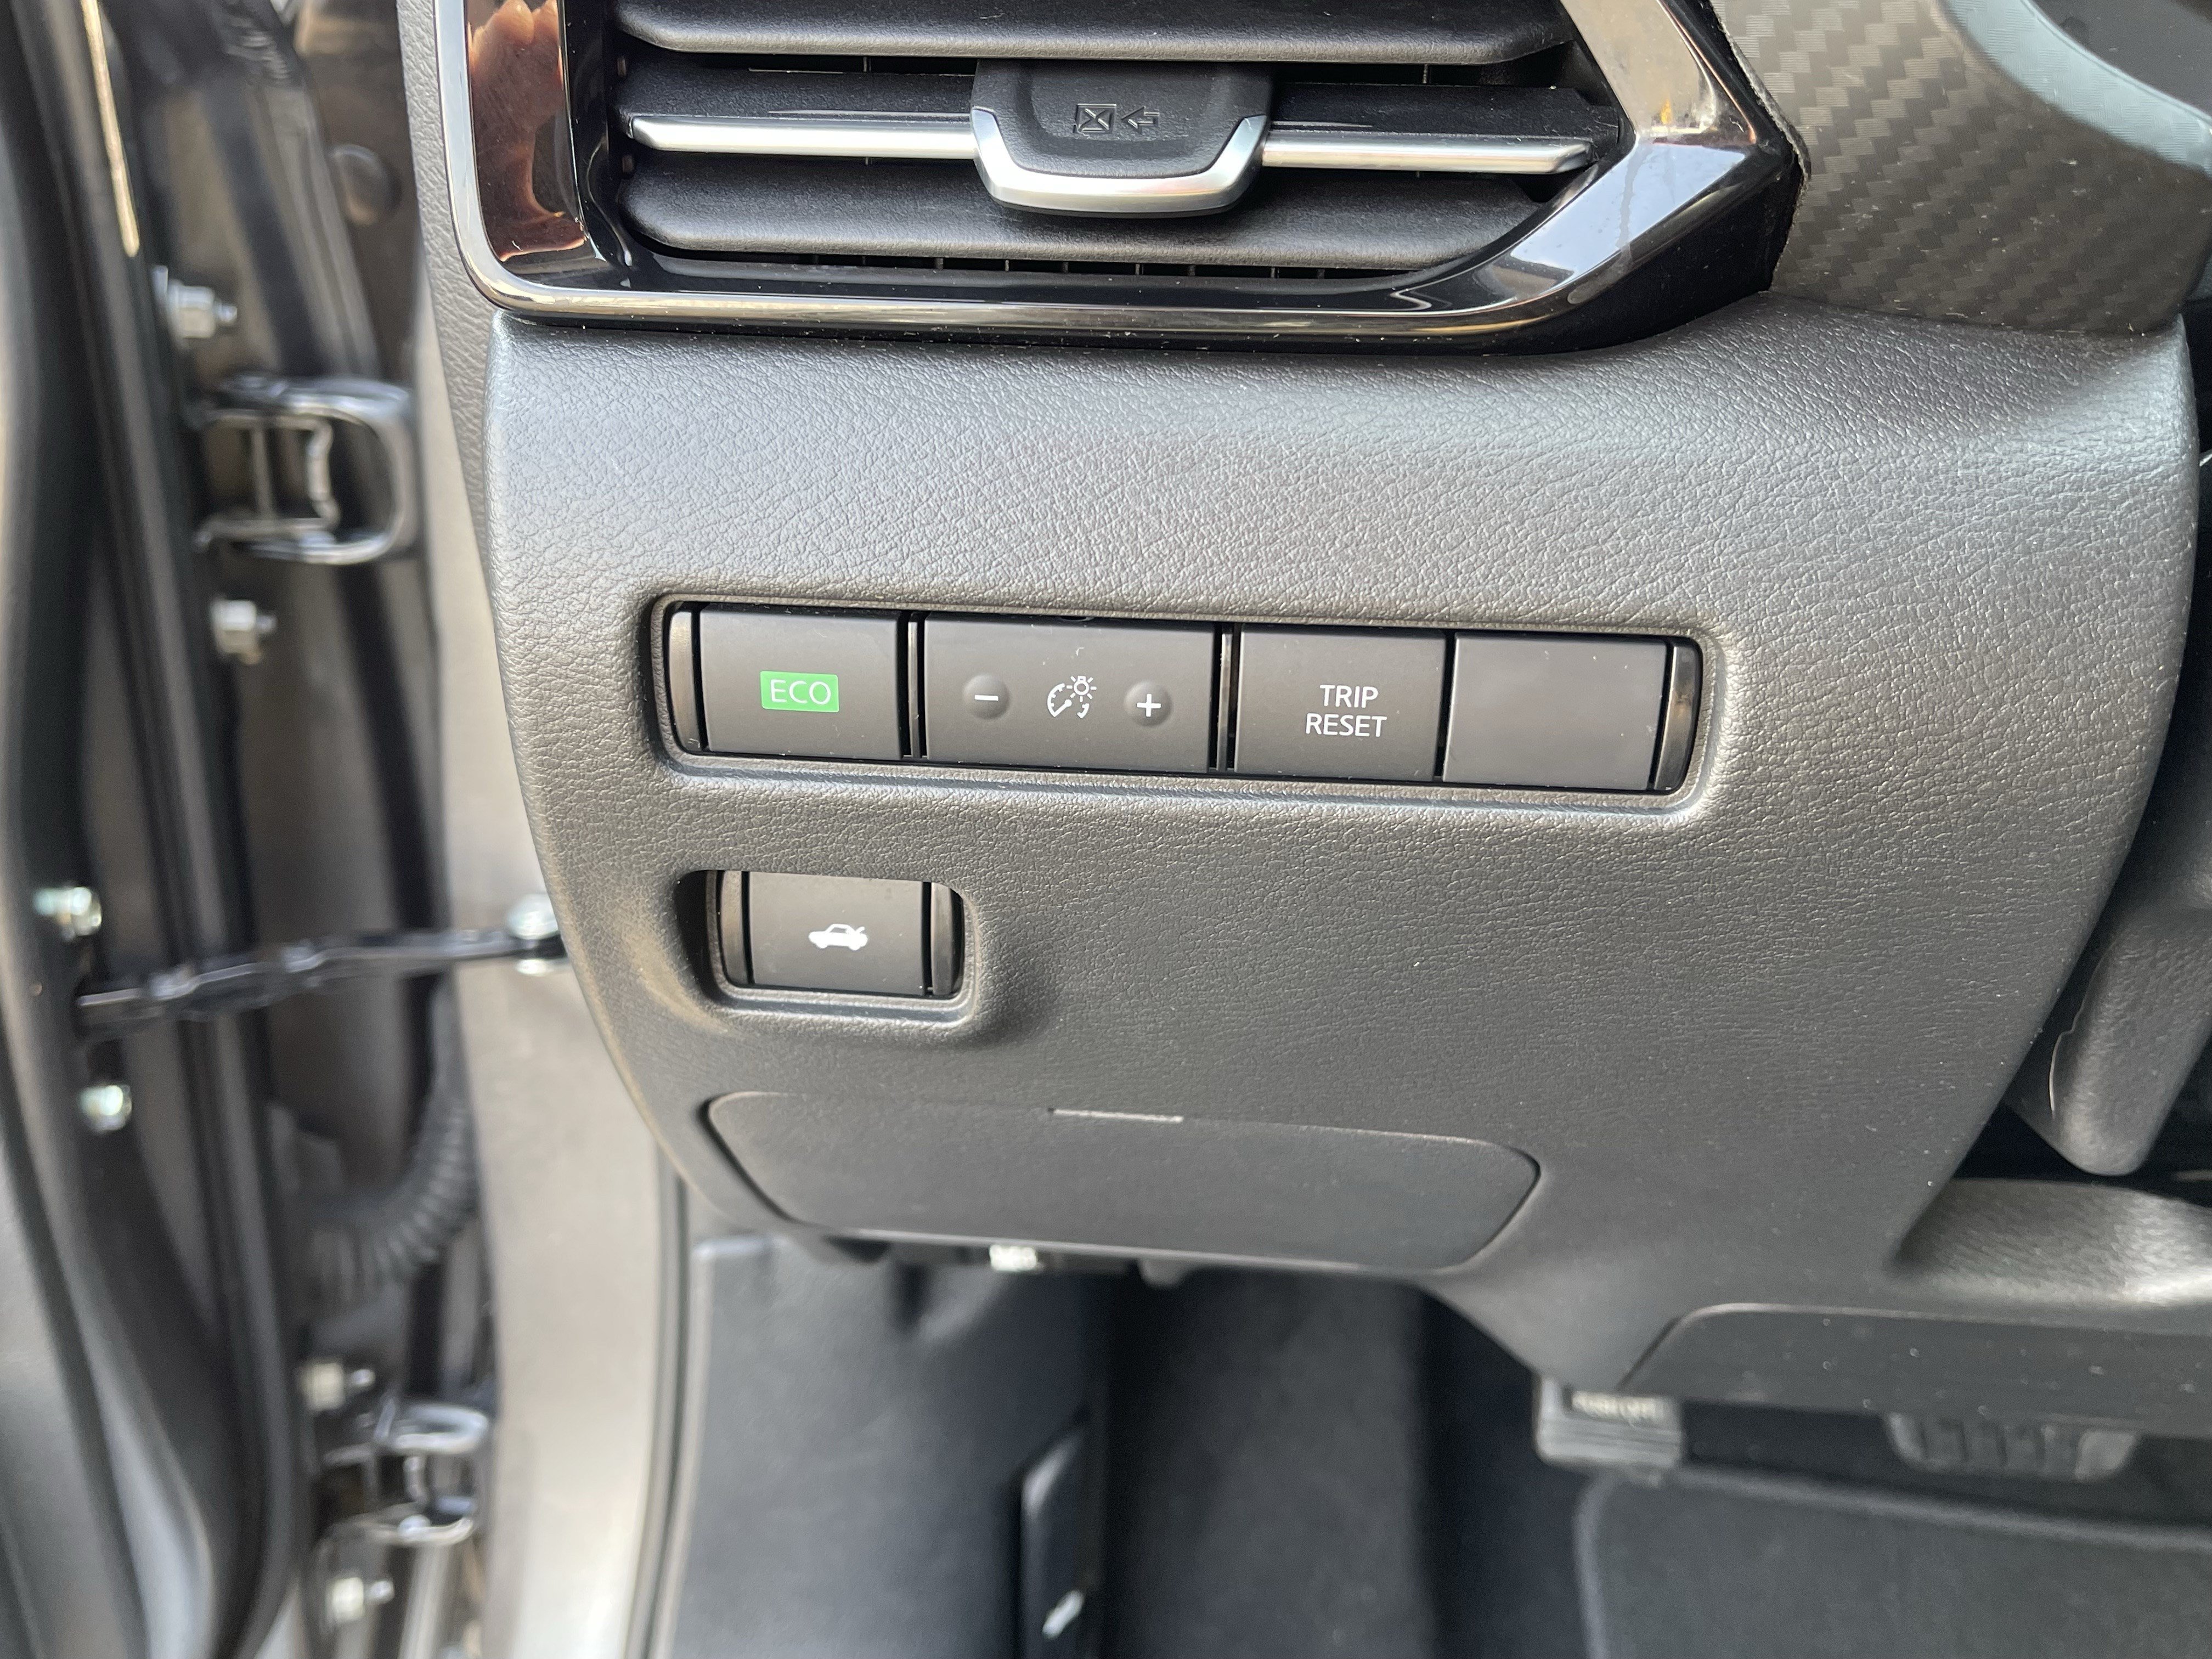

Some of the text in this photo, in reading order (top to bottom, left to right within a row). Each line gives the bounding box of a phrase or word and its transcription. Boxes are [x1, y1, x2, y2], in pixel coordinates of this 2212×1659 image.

[770, 679, 832, 705] ECO
[1319, 684, 1379, 708] TRIP
[1305, 713, 1388, 737] RESET
